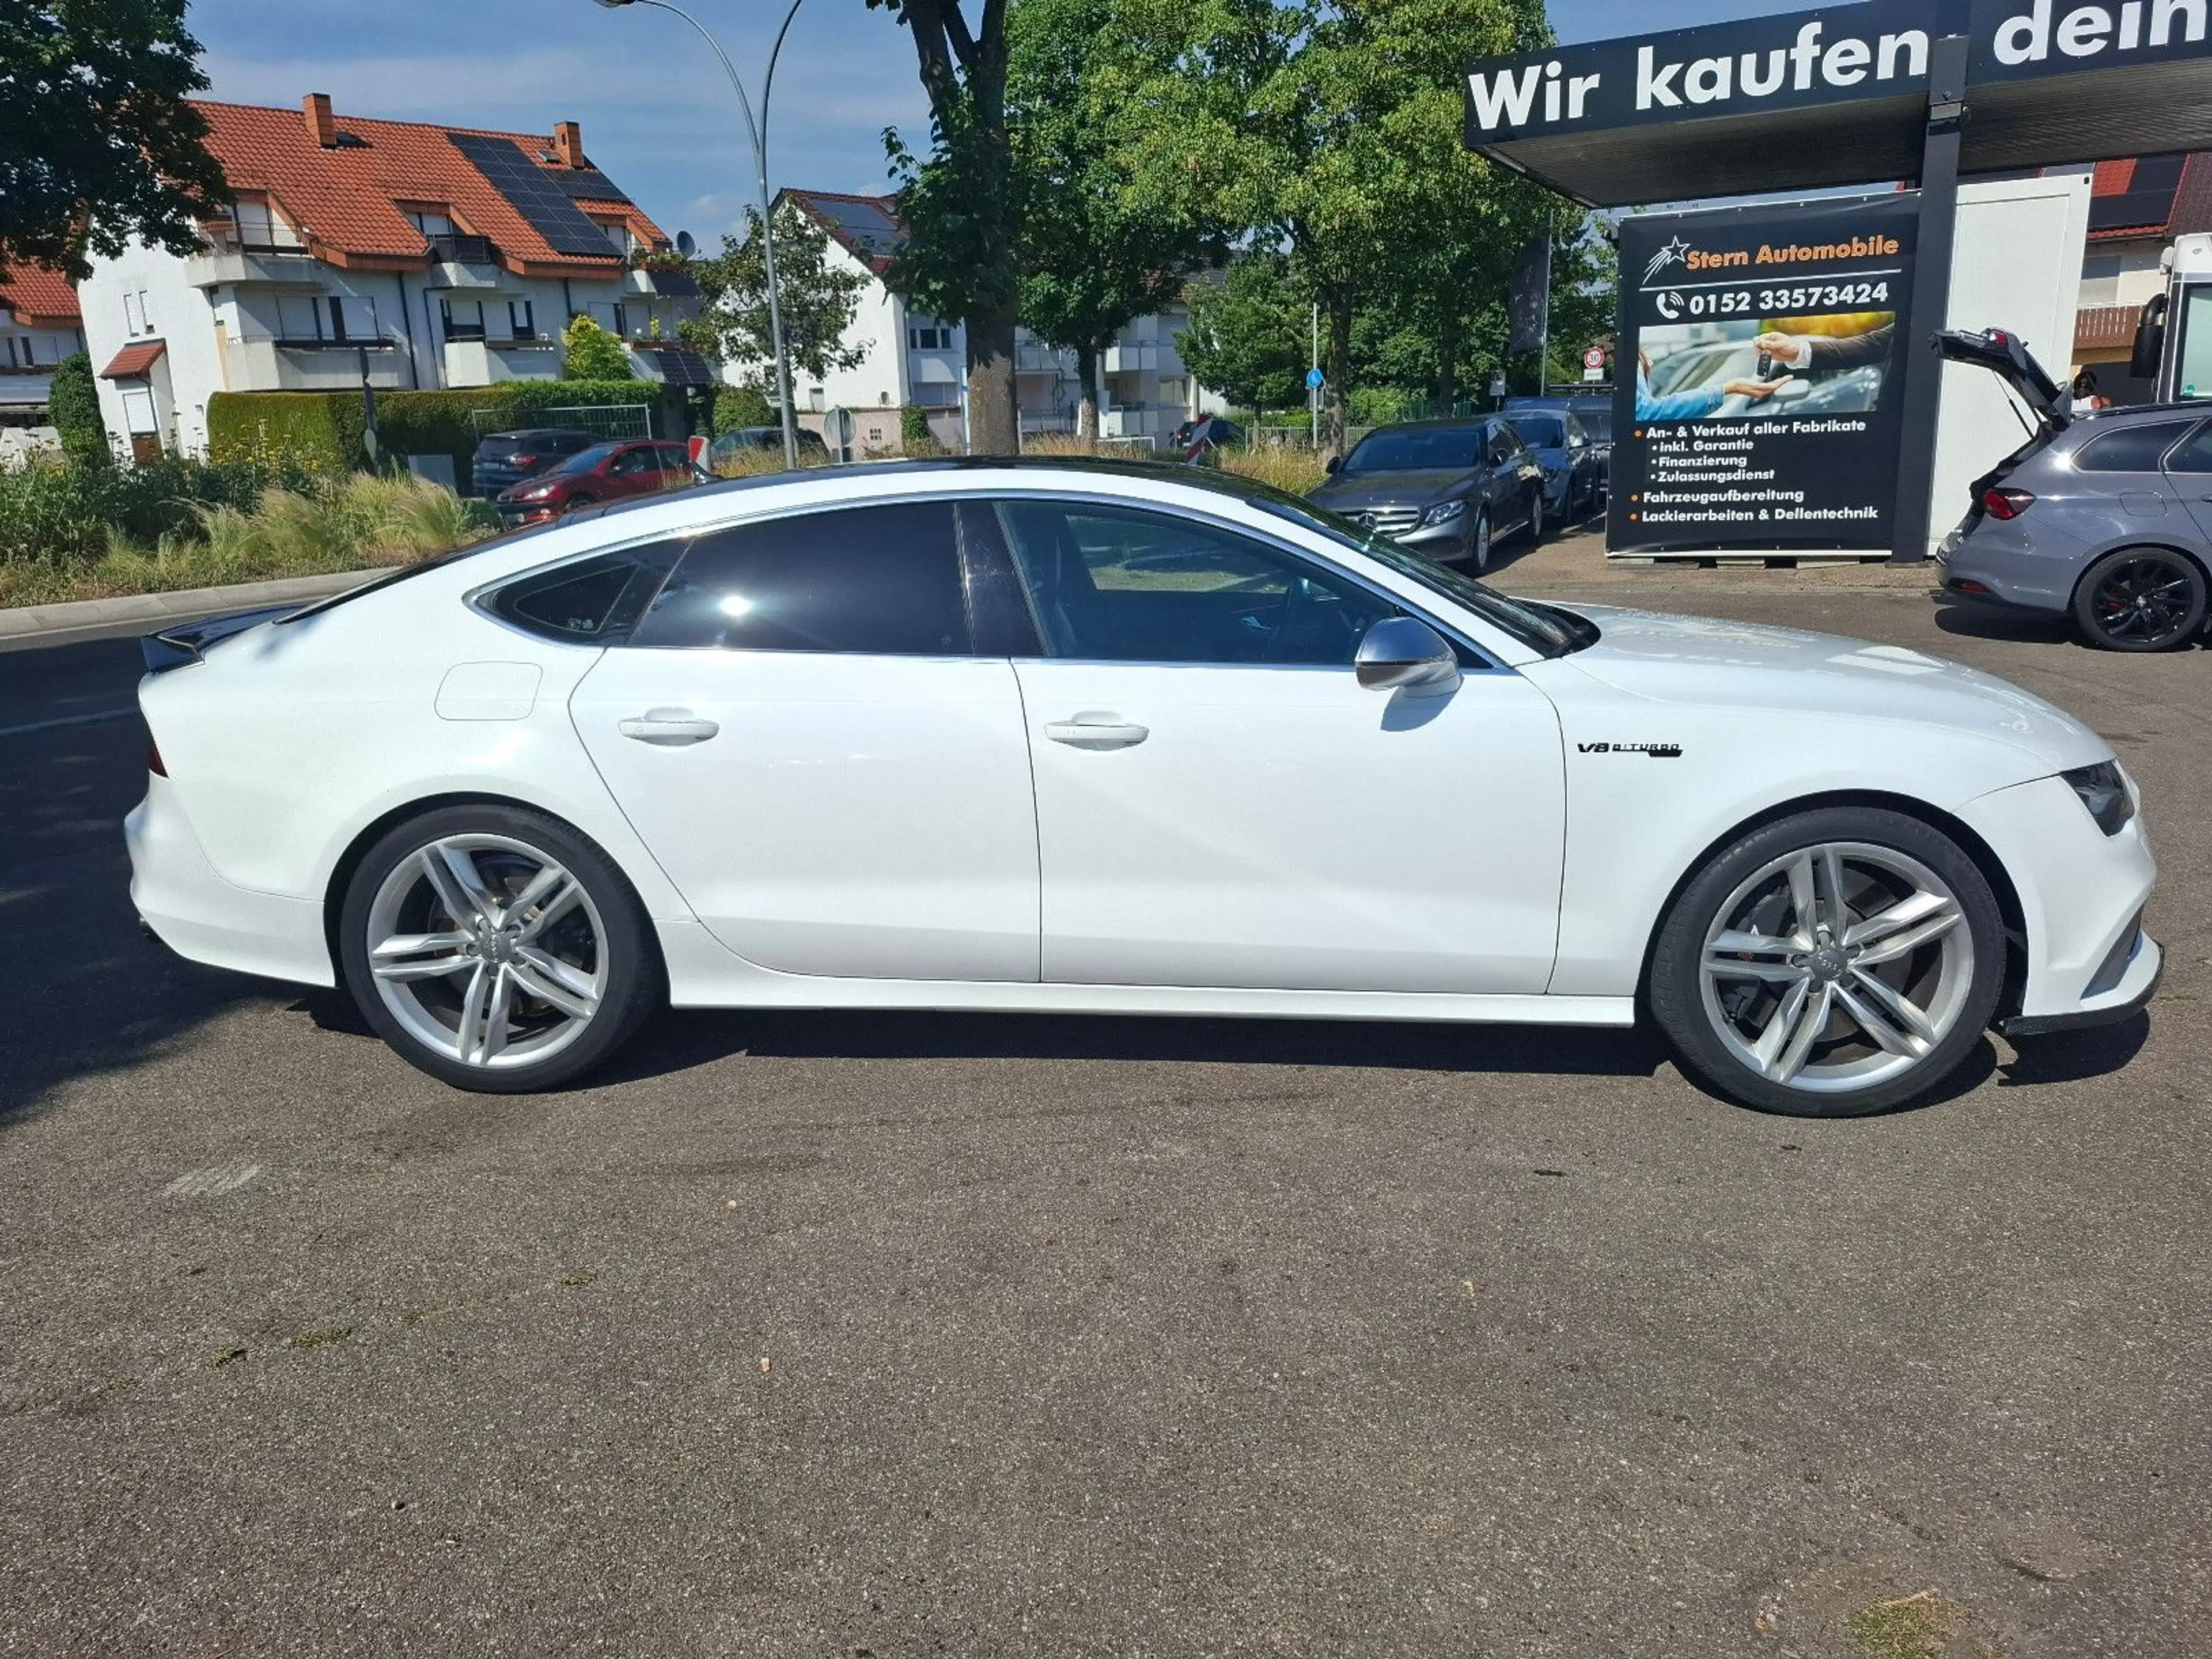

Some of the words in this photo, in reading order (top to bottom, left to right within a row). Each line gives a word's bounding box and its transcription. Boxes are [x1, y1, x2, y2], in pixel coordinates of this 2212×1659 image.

[1468, 60, 1600, 130] Wir
[1636, 22, 1929, 109] kaufen
[1993, 0, 2207, 65] dein
[1687, 250, 1749, 271] Stern
[1755, 235, 1899, 264] Automobile
[1690, 293, 1750, 315] 0152
[1759, 282, 1888, 310] 33573424
[1646, 427, 1672, 438] An-
[1677, 425, 1688, 438] &
[1693, 423, 1750, 437] Verkauf
[1753, 422, 1788, 434] aller
[1793, 420, 1866, 434] Fabrikate
[1659, 442, 1689, 452] inkl.
[1693, 438, 1754, 452] Garantie
[1659, 455, 1747, 467] Finanzierung
[1657, 469, 1775, 483] Zulassungsdienst
[1643, 489, 1804, 504] Fahrzeugaufbereitung
[1642, 509, 1754, 522] Lackierarbeiten
[1758, 509, 1770, 521] &
[1774, 506, 1878, 521] Dellentechnik
[1577, 743, 1609, 753] V8
